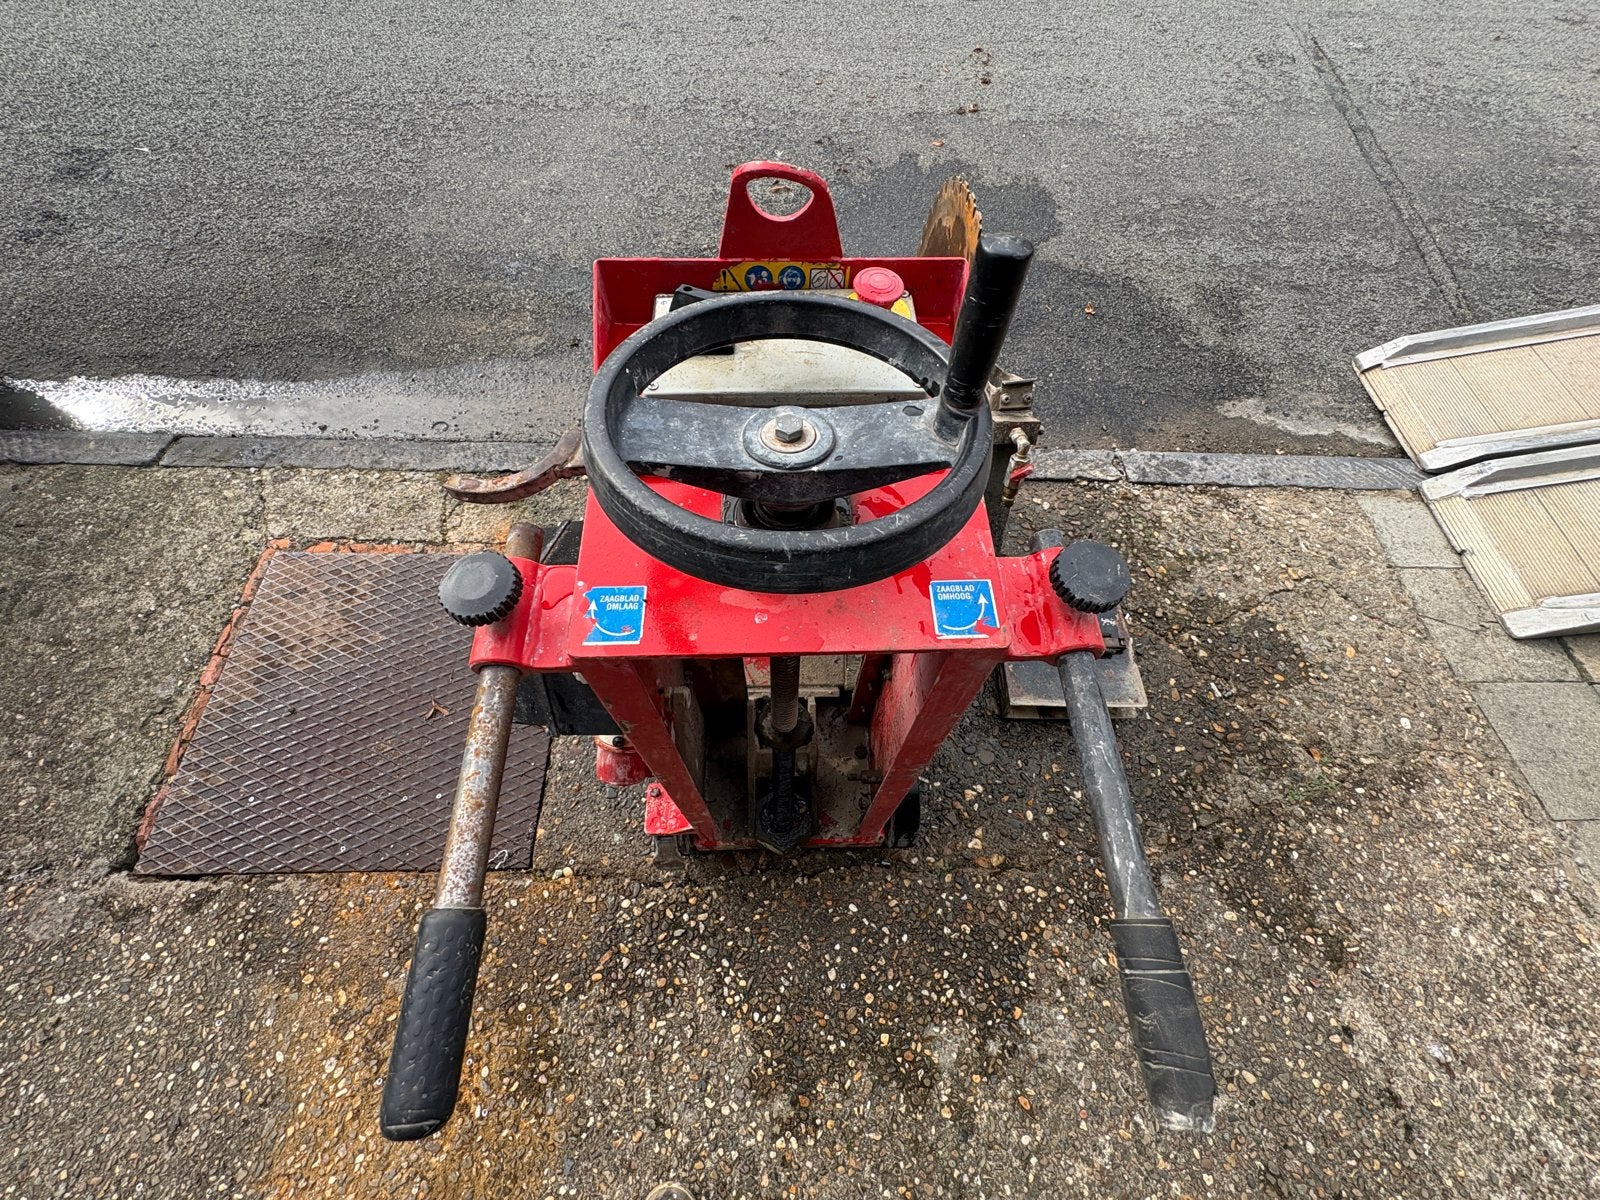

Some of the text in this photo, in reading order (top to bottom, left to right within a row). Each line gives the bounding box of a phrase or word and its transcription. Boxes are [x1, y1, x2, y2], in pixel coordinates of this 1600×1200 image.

[936, 584, 975, 593] ZAAGBLAD
[600, 594, 640, 602] ZAAGBLAD
[937, 592, 971, 601] OMHOOG
[606, 602, 639, 610] OMLAAG
